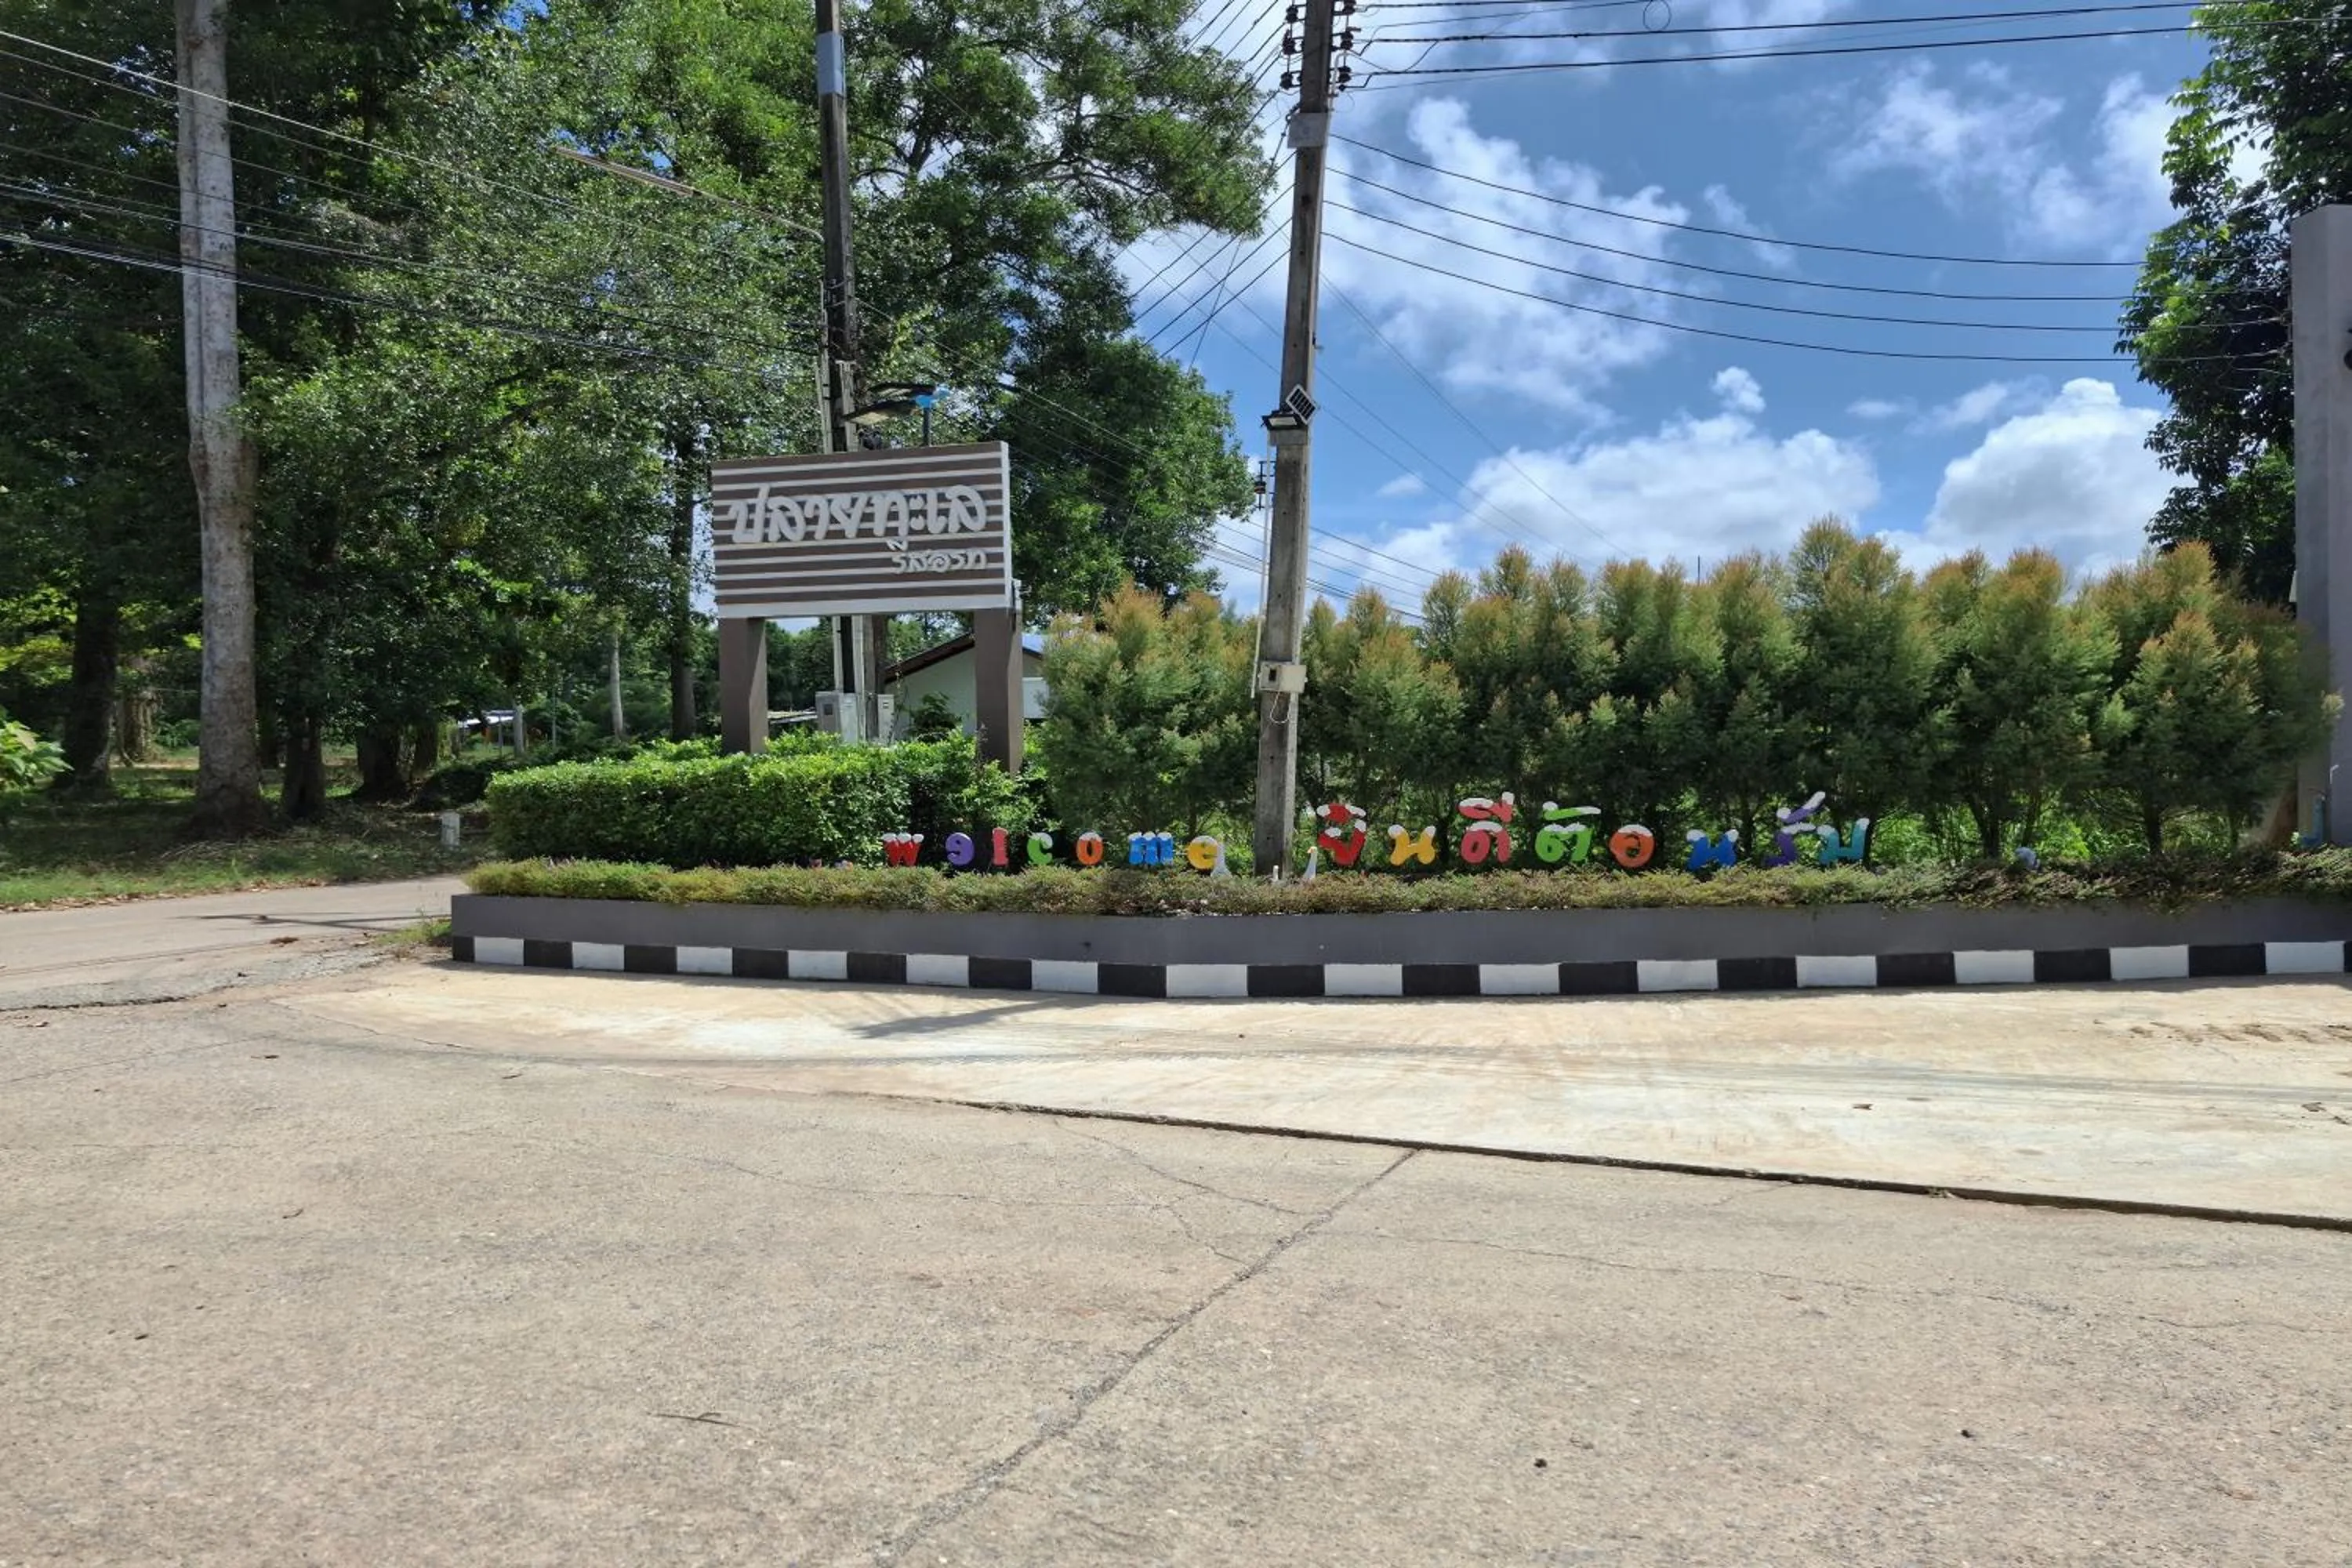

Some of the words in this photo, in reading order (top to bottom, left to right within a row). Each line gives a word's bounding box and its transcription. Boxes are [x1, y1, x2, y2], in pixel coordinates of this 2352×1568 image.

[1316, 791, 1870, 870] ยินดีต้อนรับ
